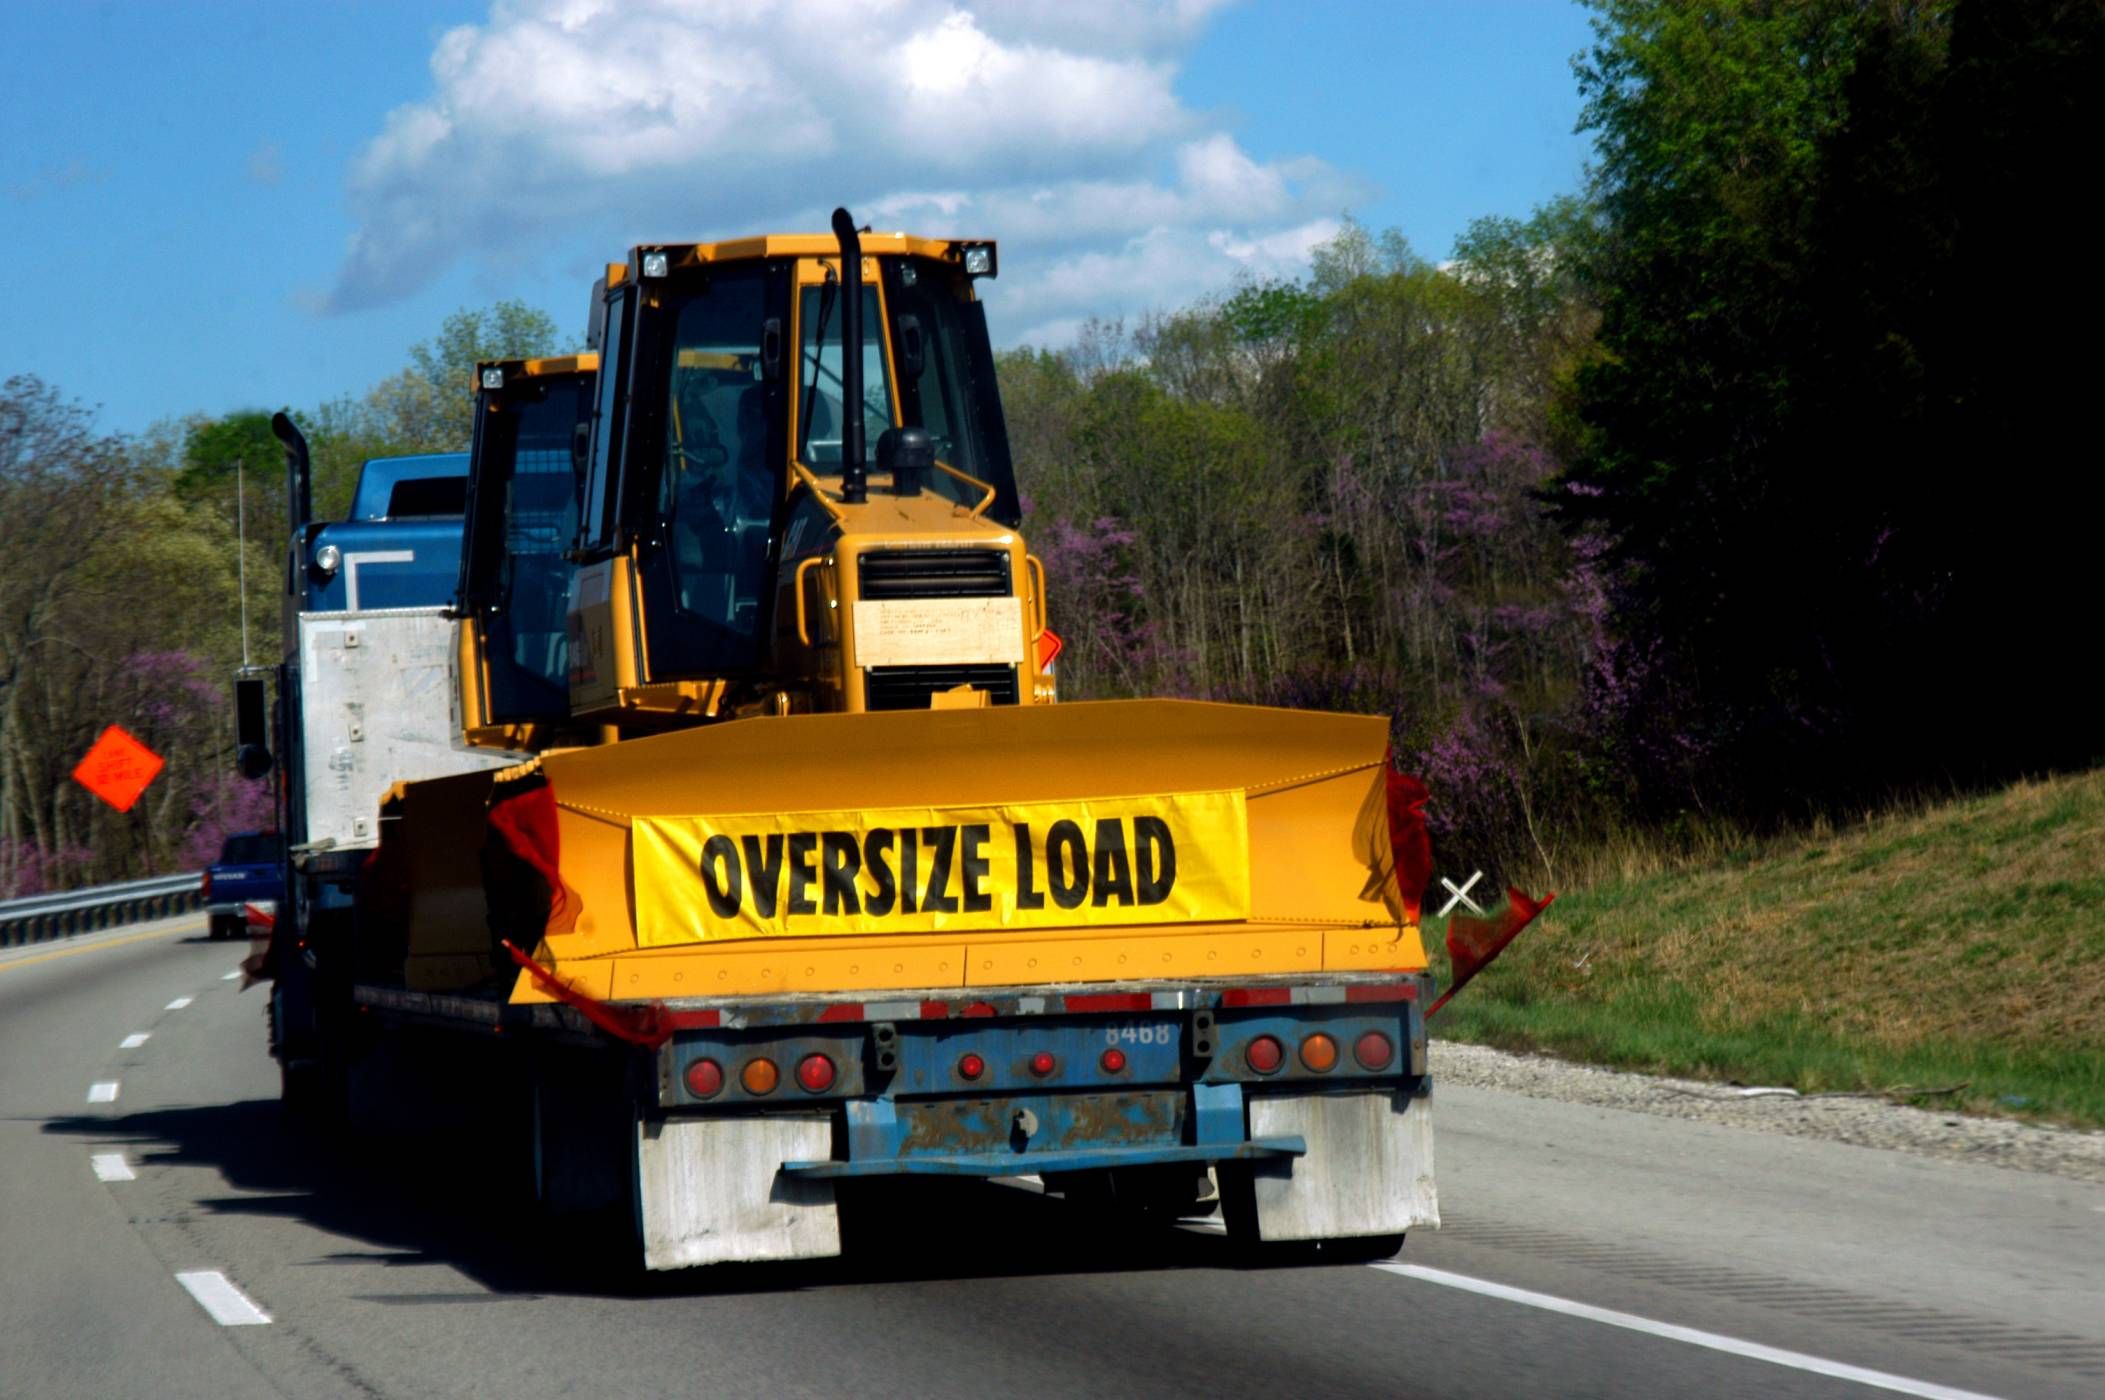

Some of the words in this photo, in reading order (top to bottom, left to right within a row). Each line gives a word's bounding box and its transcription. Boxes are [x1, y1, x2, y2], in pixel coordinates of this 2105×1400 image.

[701, 825, 992, 918] OVERSIZE
[1015, 816, 1176, 909] LOAD
[1105, 1021, 1169, 1045] 8468
